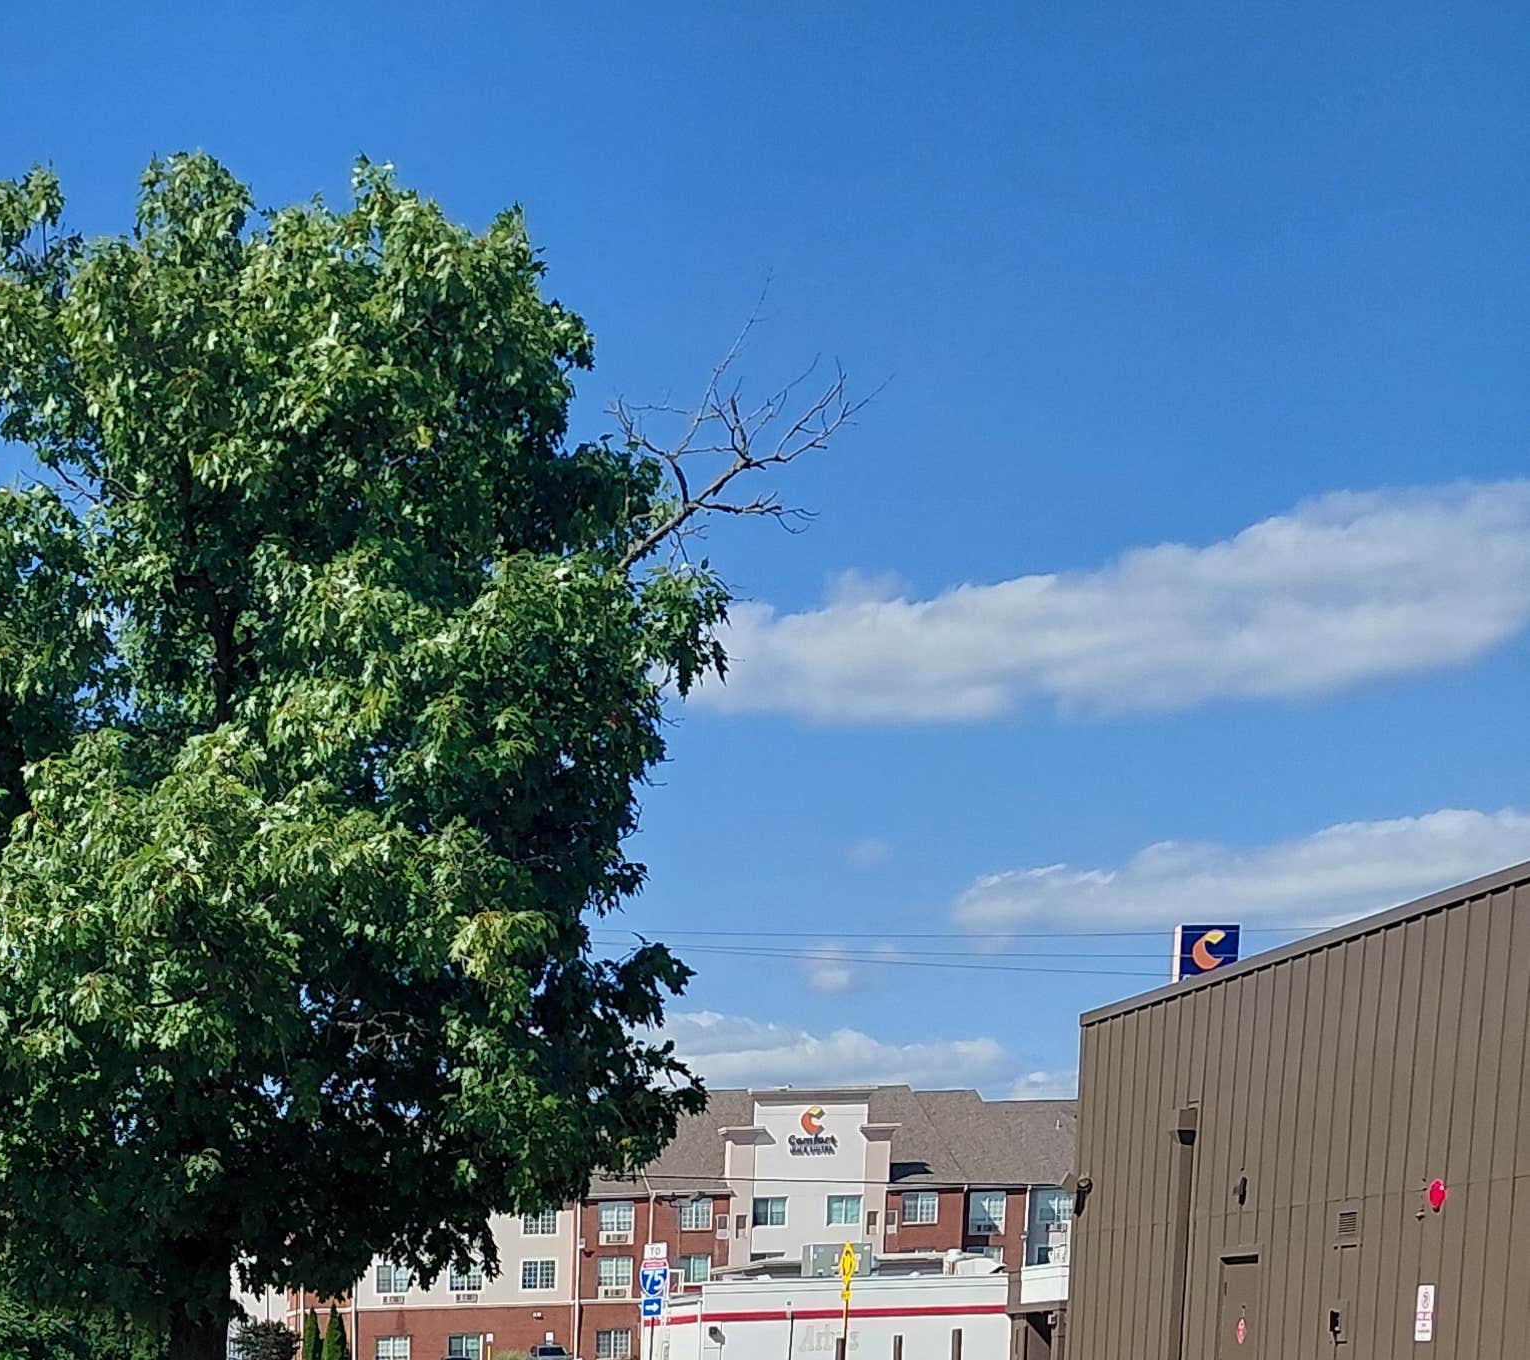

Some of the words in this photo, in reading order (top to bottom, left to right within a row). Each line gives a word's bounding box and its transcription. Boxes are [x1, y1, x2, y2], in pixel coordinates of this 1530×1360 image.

[788, 1134, 838, 1147] Comfort
[650, 1246, 661, 1255] TO
[643, 1269, 665, 1291] 75
